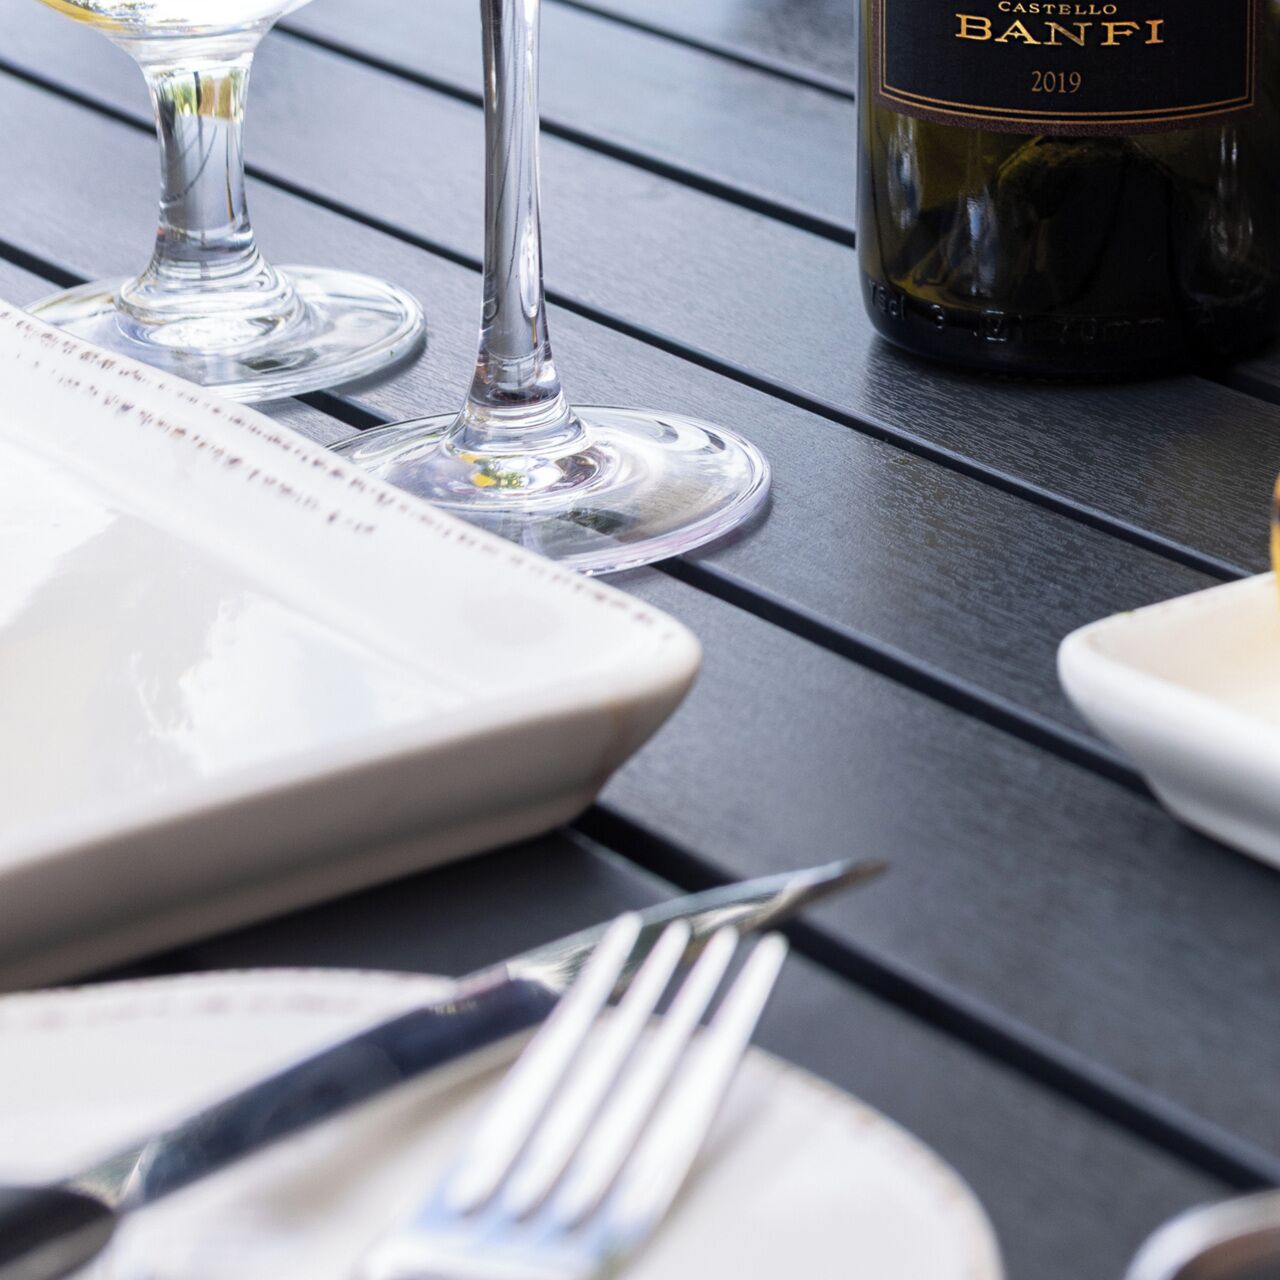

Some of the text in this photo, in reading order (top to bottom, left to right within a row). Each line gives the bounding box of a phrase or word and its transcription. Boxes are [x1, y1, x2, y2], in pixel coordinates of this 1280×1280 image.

[998, 1, 1117, 15] CASTELLO
[955, 13, 1164, 46] BANFI
[1031, 70, 1082, 93] 2019
